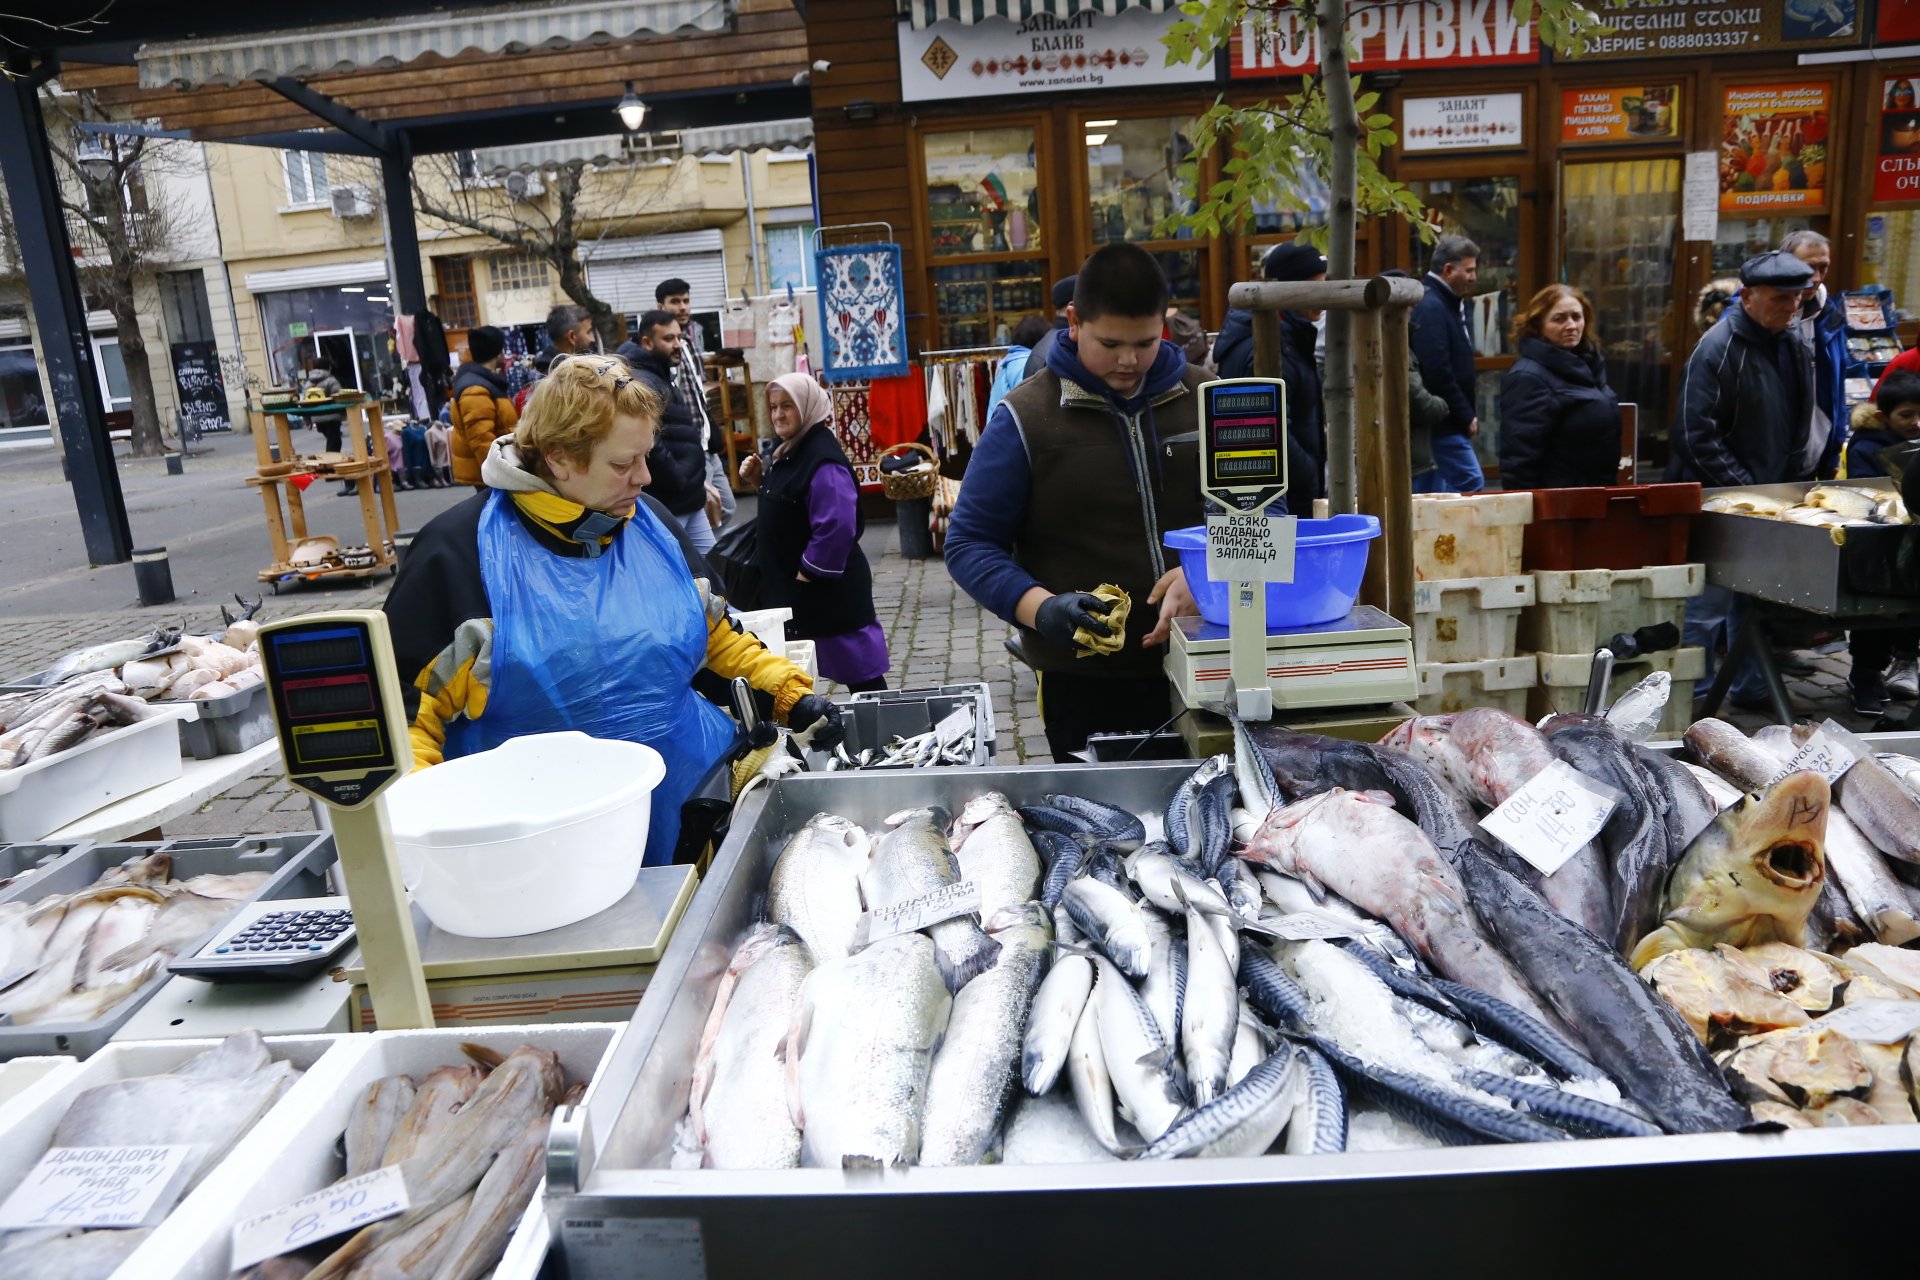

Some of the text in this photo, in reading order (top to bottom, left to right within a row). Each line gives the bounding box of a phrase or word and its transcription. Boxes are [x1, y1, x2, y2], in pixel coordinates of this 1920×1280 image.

[1694, 8, 1761, 25] СТОКИ
[1241, 0, 1531, 69] ПОРИВКИ
[1659, 31, 1749, 49] 0888033337
[1031, 34, 1084, 52] БЛАЙВ
[1019, 72, 1104, 87] www.zanaiat.bg
[1578, 94, 1610, 102] ТАХАН
[1728, 101, 1760, 111] турски
[1771, 98, 1824, 108] български
[1437, 98, 1488, 113] ЗАНАЯТ
[1574, 104, 1614, 114] ПЕТМЕЗ
[1565, 114, 1622, 125] ПИШМАНИЕ
[1576, 126, 1610, 136] ХАЛВА
[1736, 193, 1805, 205] ПОДПРАВКИ
[1229, 516, 1268, 527] ВСЯКО
[1209, 526, 1271, 541] СЛЕДВАЩО
[1212, 536, 1258, 548] ПЛИКЧЕ
[1216, 547, 1277, 564] ЗАПЛАЩА
[334, 784, 361, 793] DATECS
[1503, 791, 1538, 824] СОМ
[473, 994, 491, 1002] DIGITAL
[492, 993, 520, 1001] COMPUTING
